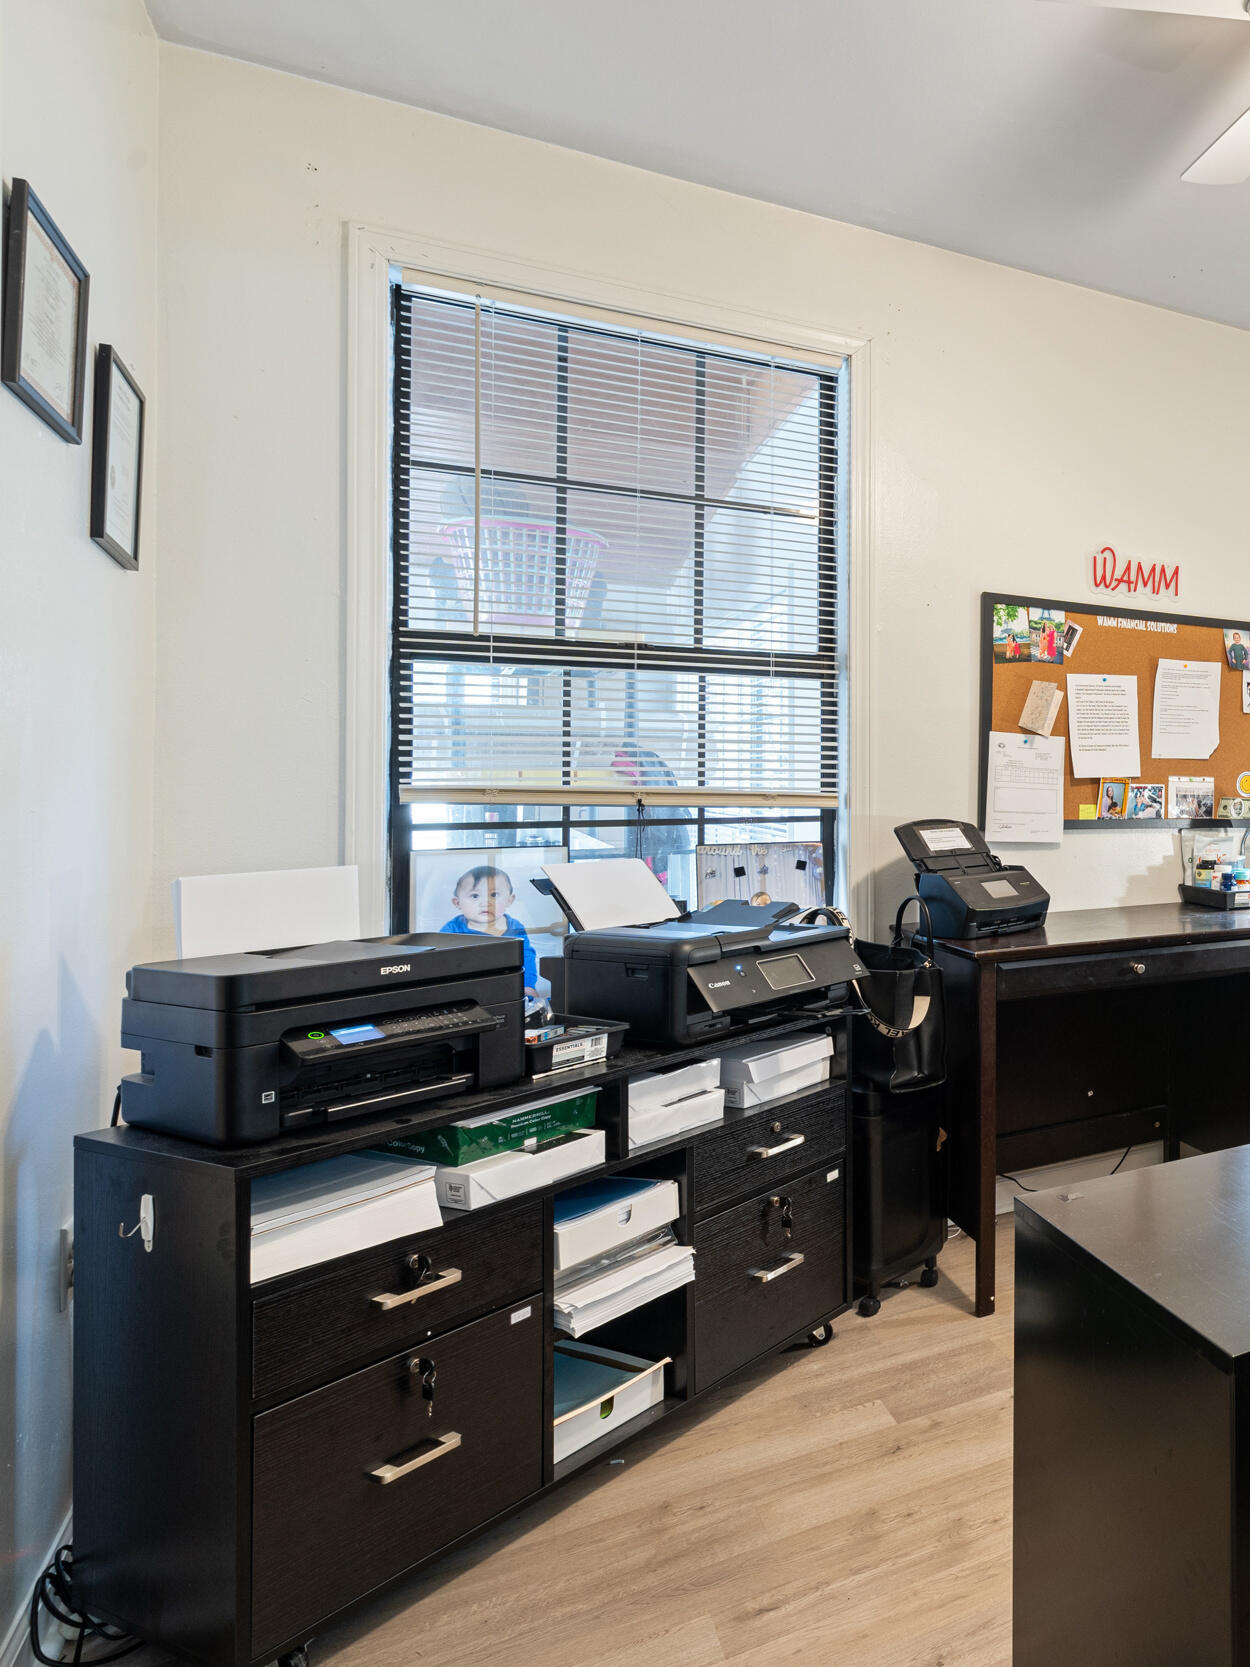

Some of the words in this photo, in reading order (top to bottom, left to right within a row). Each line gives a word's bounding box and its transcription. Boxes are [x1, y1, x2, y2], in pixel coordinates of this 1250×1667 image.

[1093, 546, 1179, 597] WAMM
[1096, 615, 1117, 627] WAMM
[1118, 617, 1146, 631] FINANCIAL
[1147, 620, 1178, 634] SOLUTIONS
[380, 964, 411, 975] EPSON
[708, 980, 731, 989] Canon
